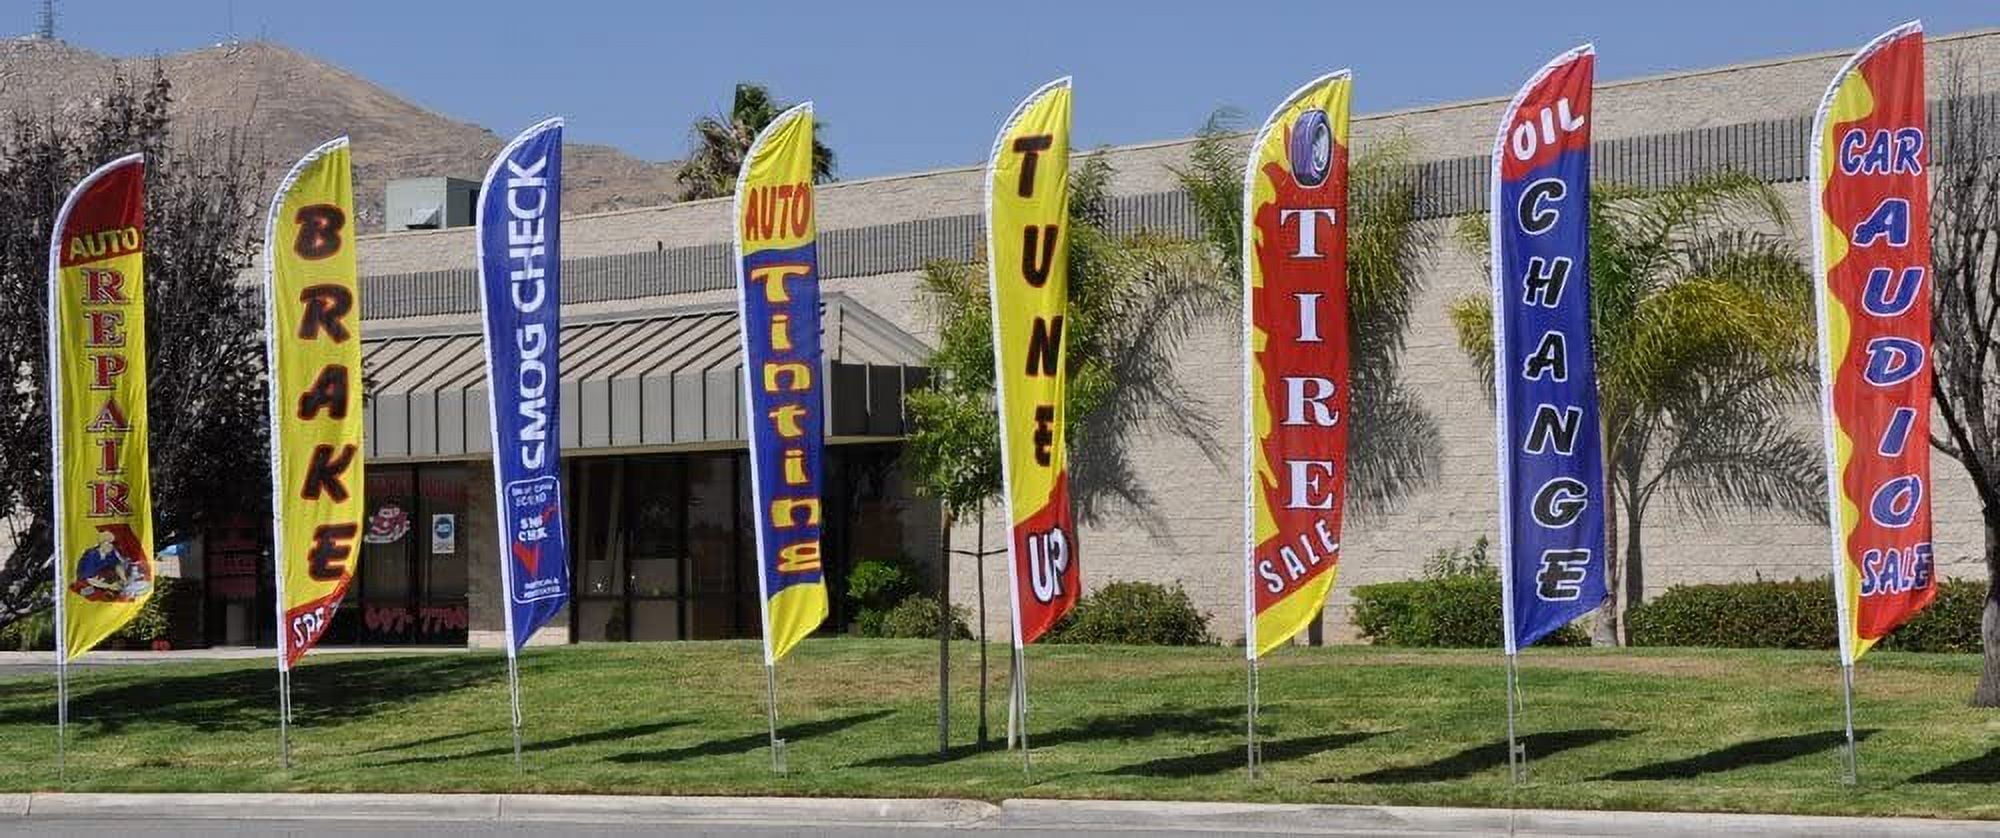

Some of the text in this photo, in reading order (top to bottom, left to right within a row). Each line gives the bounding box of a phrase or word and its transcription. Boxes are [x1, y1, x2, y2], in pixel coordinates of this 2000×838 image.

[1512, 97, 1585, 161] OIL
[1840, 127, 1924, 176] CAR
[69, 226, 139, 261] AUTO
[507, 155, 547, 314] CHECK
[745, 182, 812, 242] AUTO
[1012, 134, 1064, 467] TUNE
[1279, 207, 1339, 510] TIRE
[1851, 198, 1925, 528] AUDIO
[81, 267, 134, 518] REPAIR
[293, 203, 358, 582] BRAKE
[515, 323, 547, 470] SMOG
[1518, 178, 1591, 601] CHANGE
[1028, 527, 1070, 604] UP
[1259, 518, 1339, 594] SALE
[1860, 543, 1933, 596] SALE
